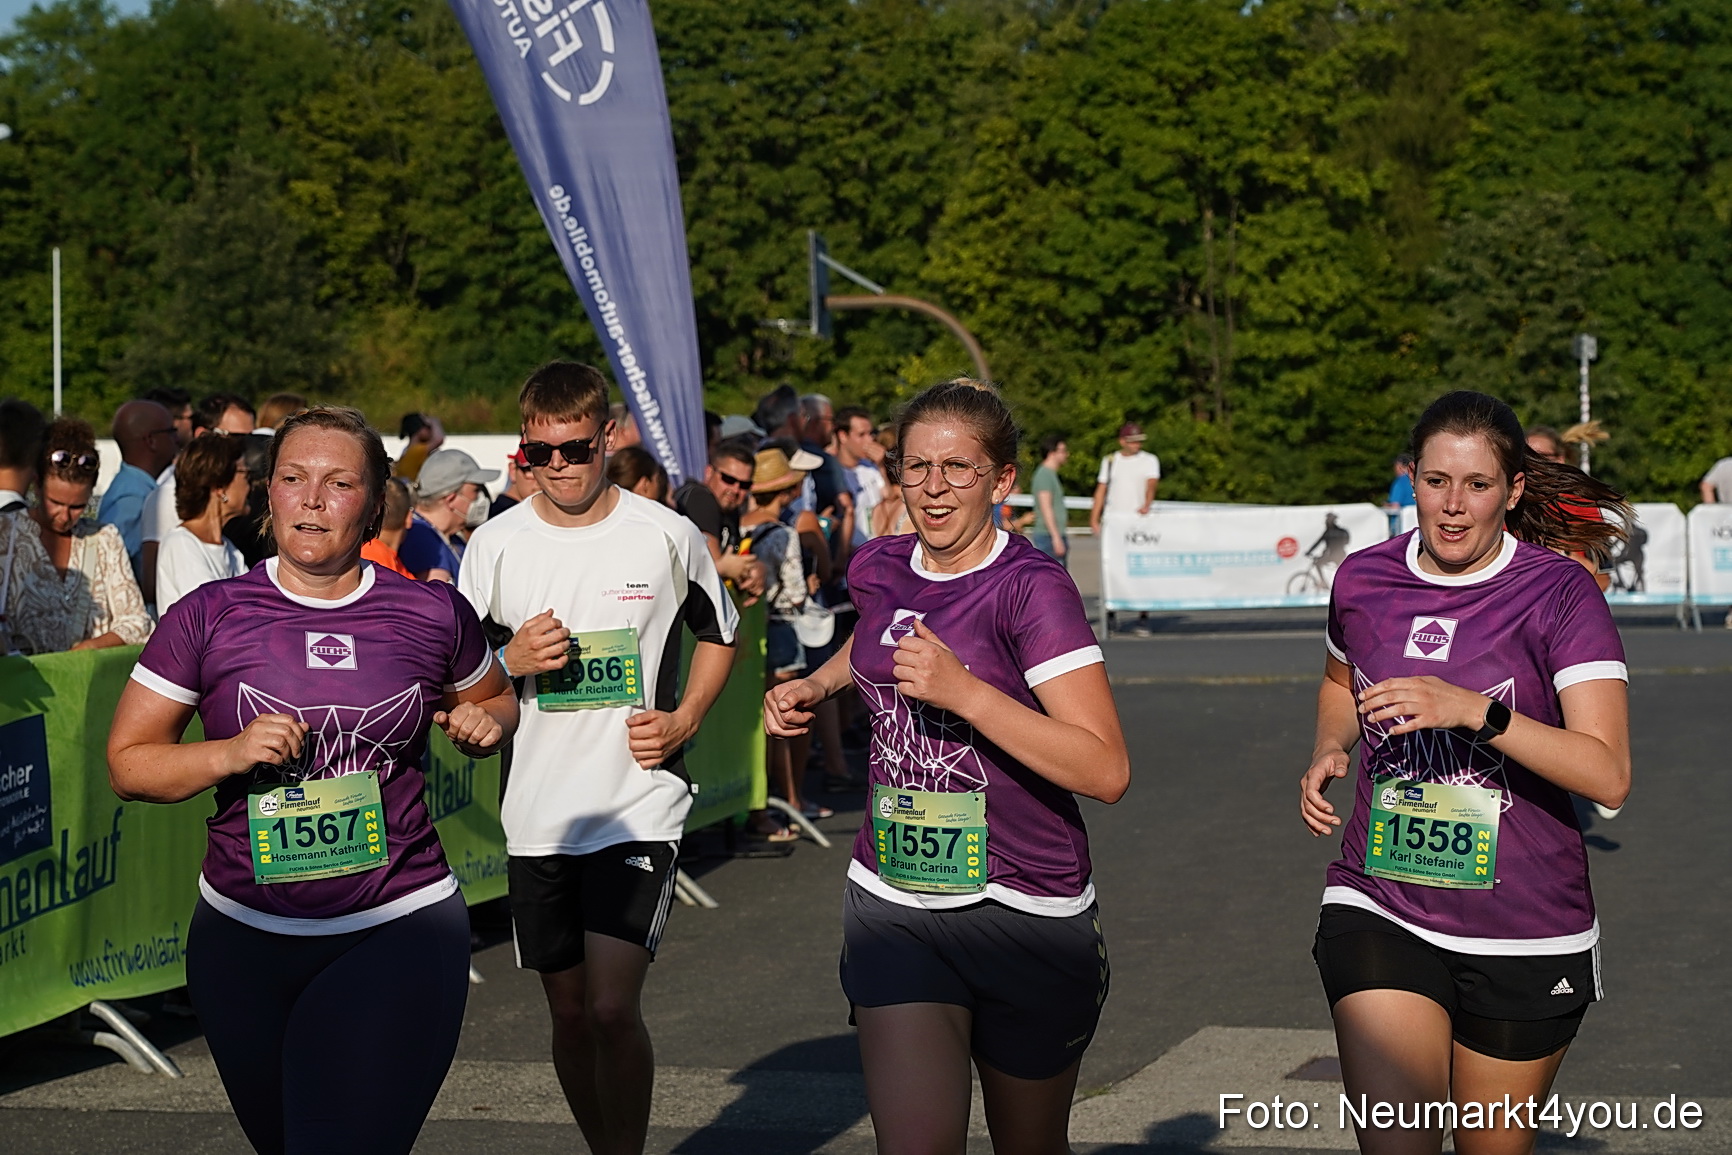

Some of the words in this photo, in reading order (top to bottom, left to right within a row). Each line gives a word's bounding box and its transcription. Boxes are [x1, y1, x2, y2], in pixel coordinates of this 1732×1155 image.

[310, 646, 351, 655] FUCHS
[1411, 632, 1450, 644] FUCHS
[585, 684, 623, 695] Richard
[625, 658, 637, 694] 2022
[280, 797, 321, 810] Firmenlauf
[296, 805, 321, 813] neumarkt
[893, 807, 926, 816] Firmenlauf
[1398, 798, 1438, 809] Firmenlauf
[272, 809, 360, 850] 1567
[364, 809, 381, 855] 2022
[887, 822, 963, 860] 1557
[1373, 821, 1385, 856] RUN
[1387, 814, 1473, 855] 1558
[256, 830, 272, 864] RUN
[271, 849, 328, 863] Hosemann
[329, 841, 369, 857] Kathrin
[877, 830, 886, 864] RUN
[966, 833, 979, 878] 2022
[1389, 849, 1412, 863] Karl
[1414, 853, 1465, 870] Stefanie
[1475, 830, 1490, 875] 2022
[890, 857, 917, 871] Braun
[919, 861, 958, 874] Carina
